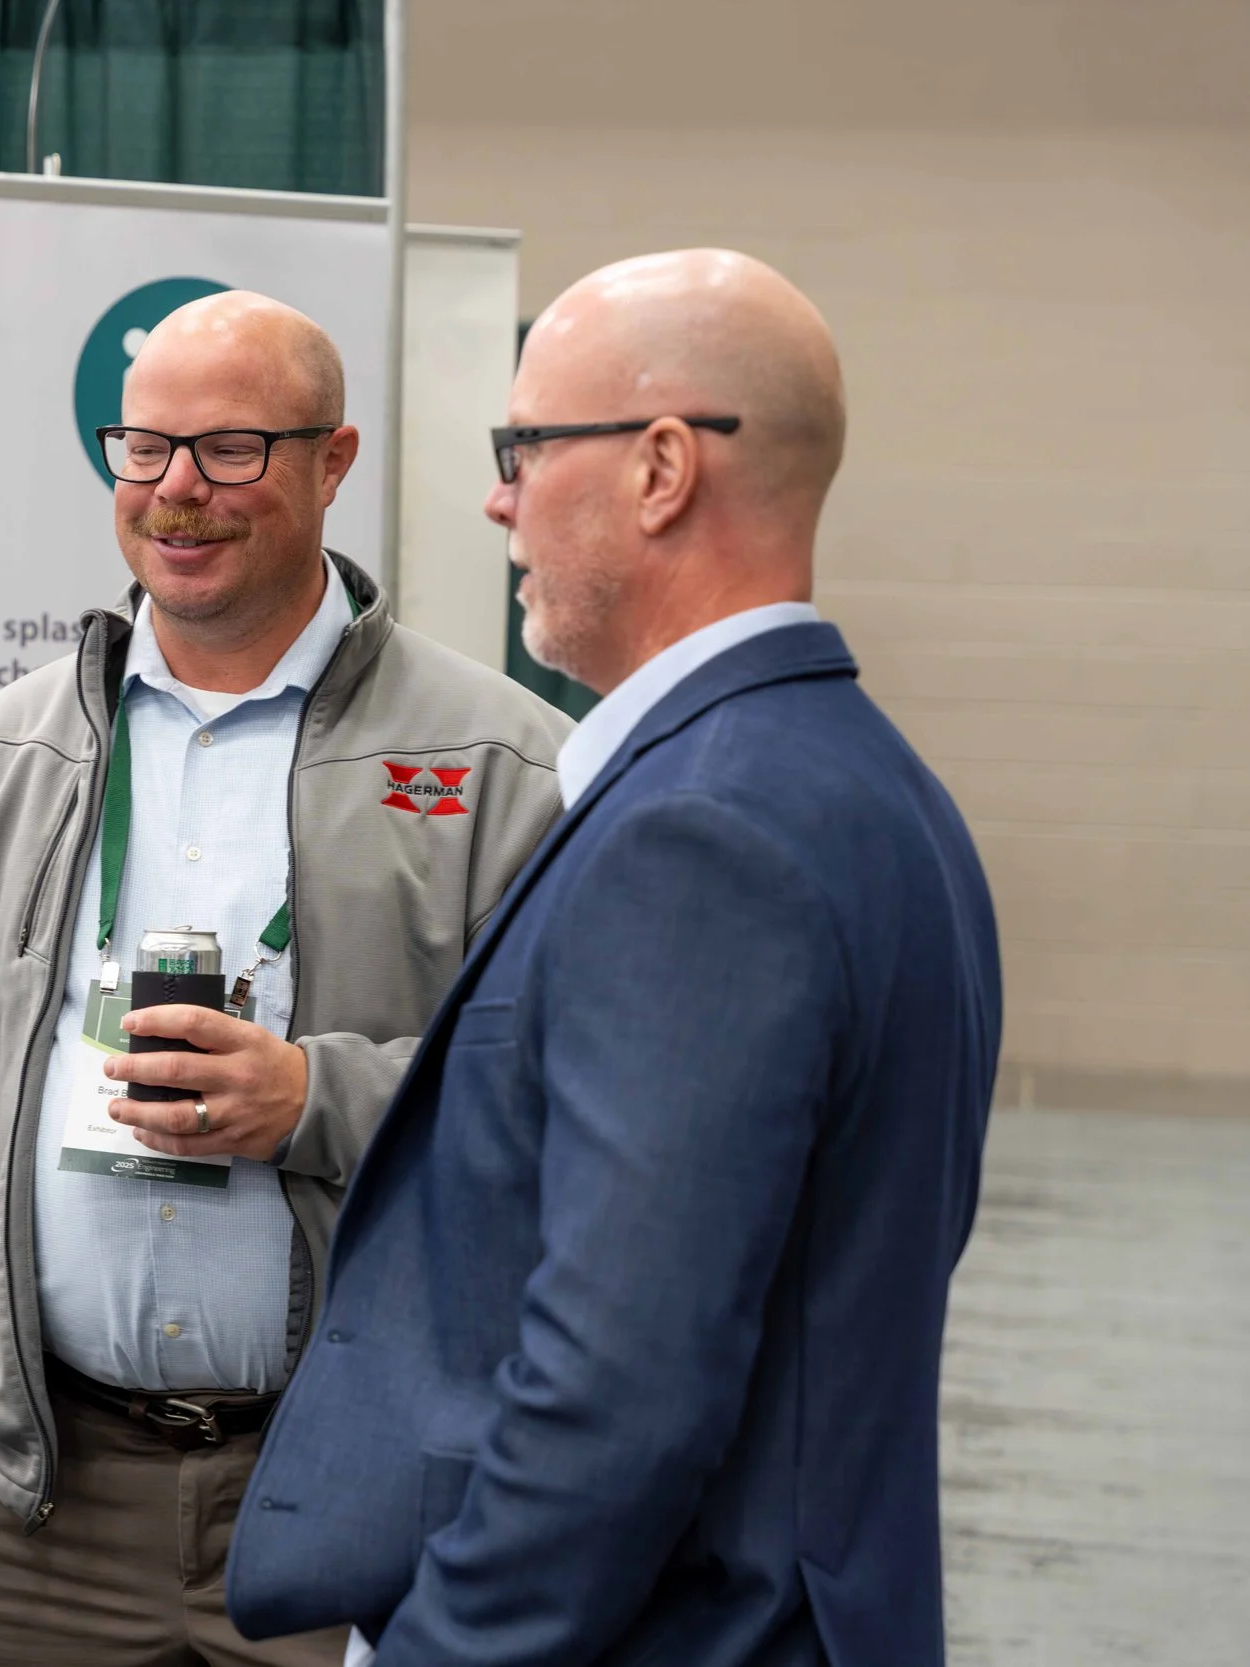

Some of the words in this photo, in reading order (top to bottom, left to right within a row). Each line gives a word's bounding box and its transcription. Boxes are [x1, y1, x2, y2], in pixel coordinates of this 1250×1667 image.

[387, 779, 463, 796] HAGERMAN
[97, 1085, 120, 1096] Brad
[114, 1160, 135, 1169] 2025
